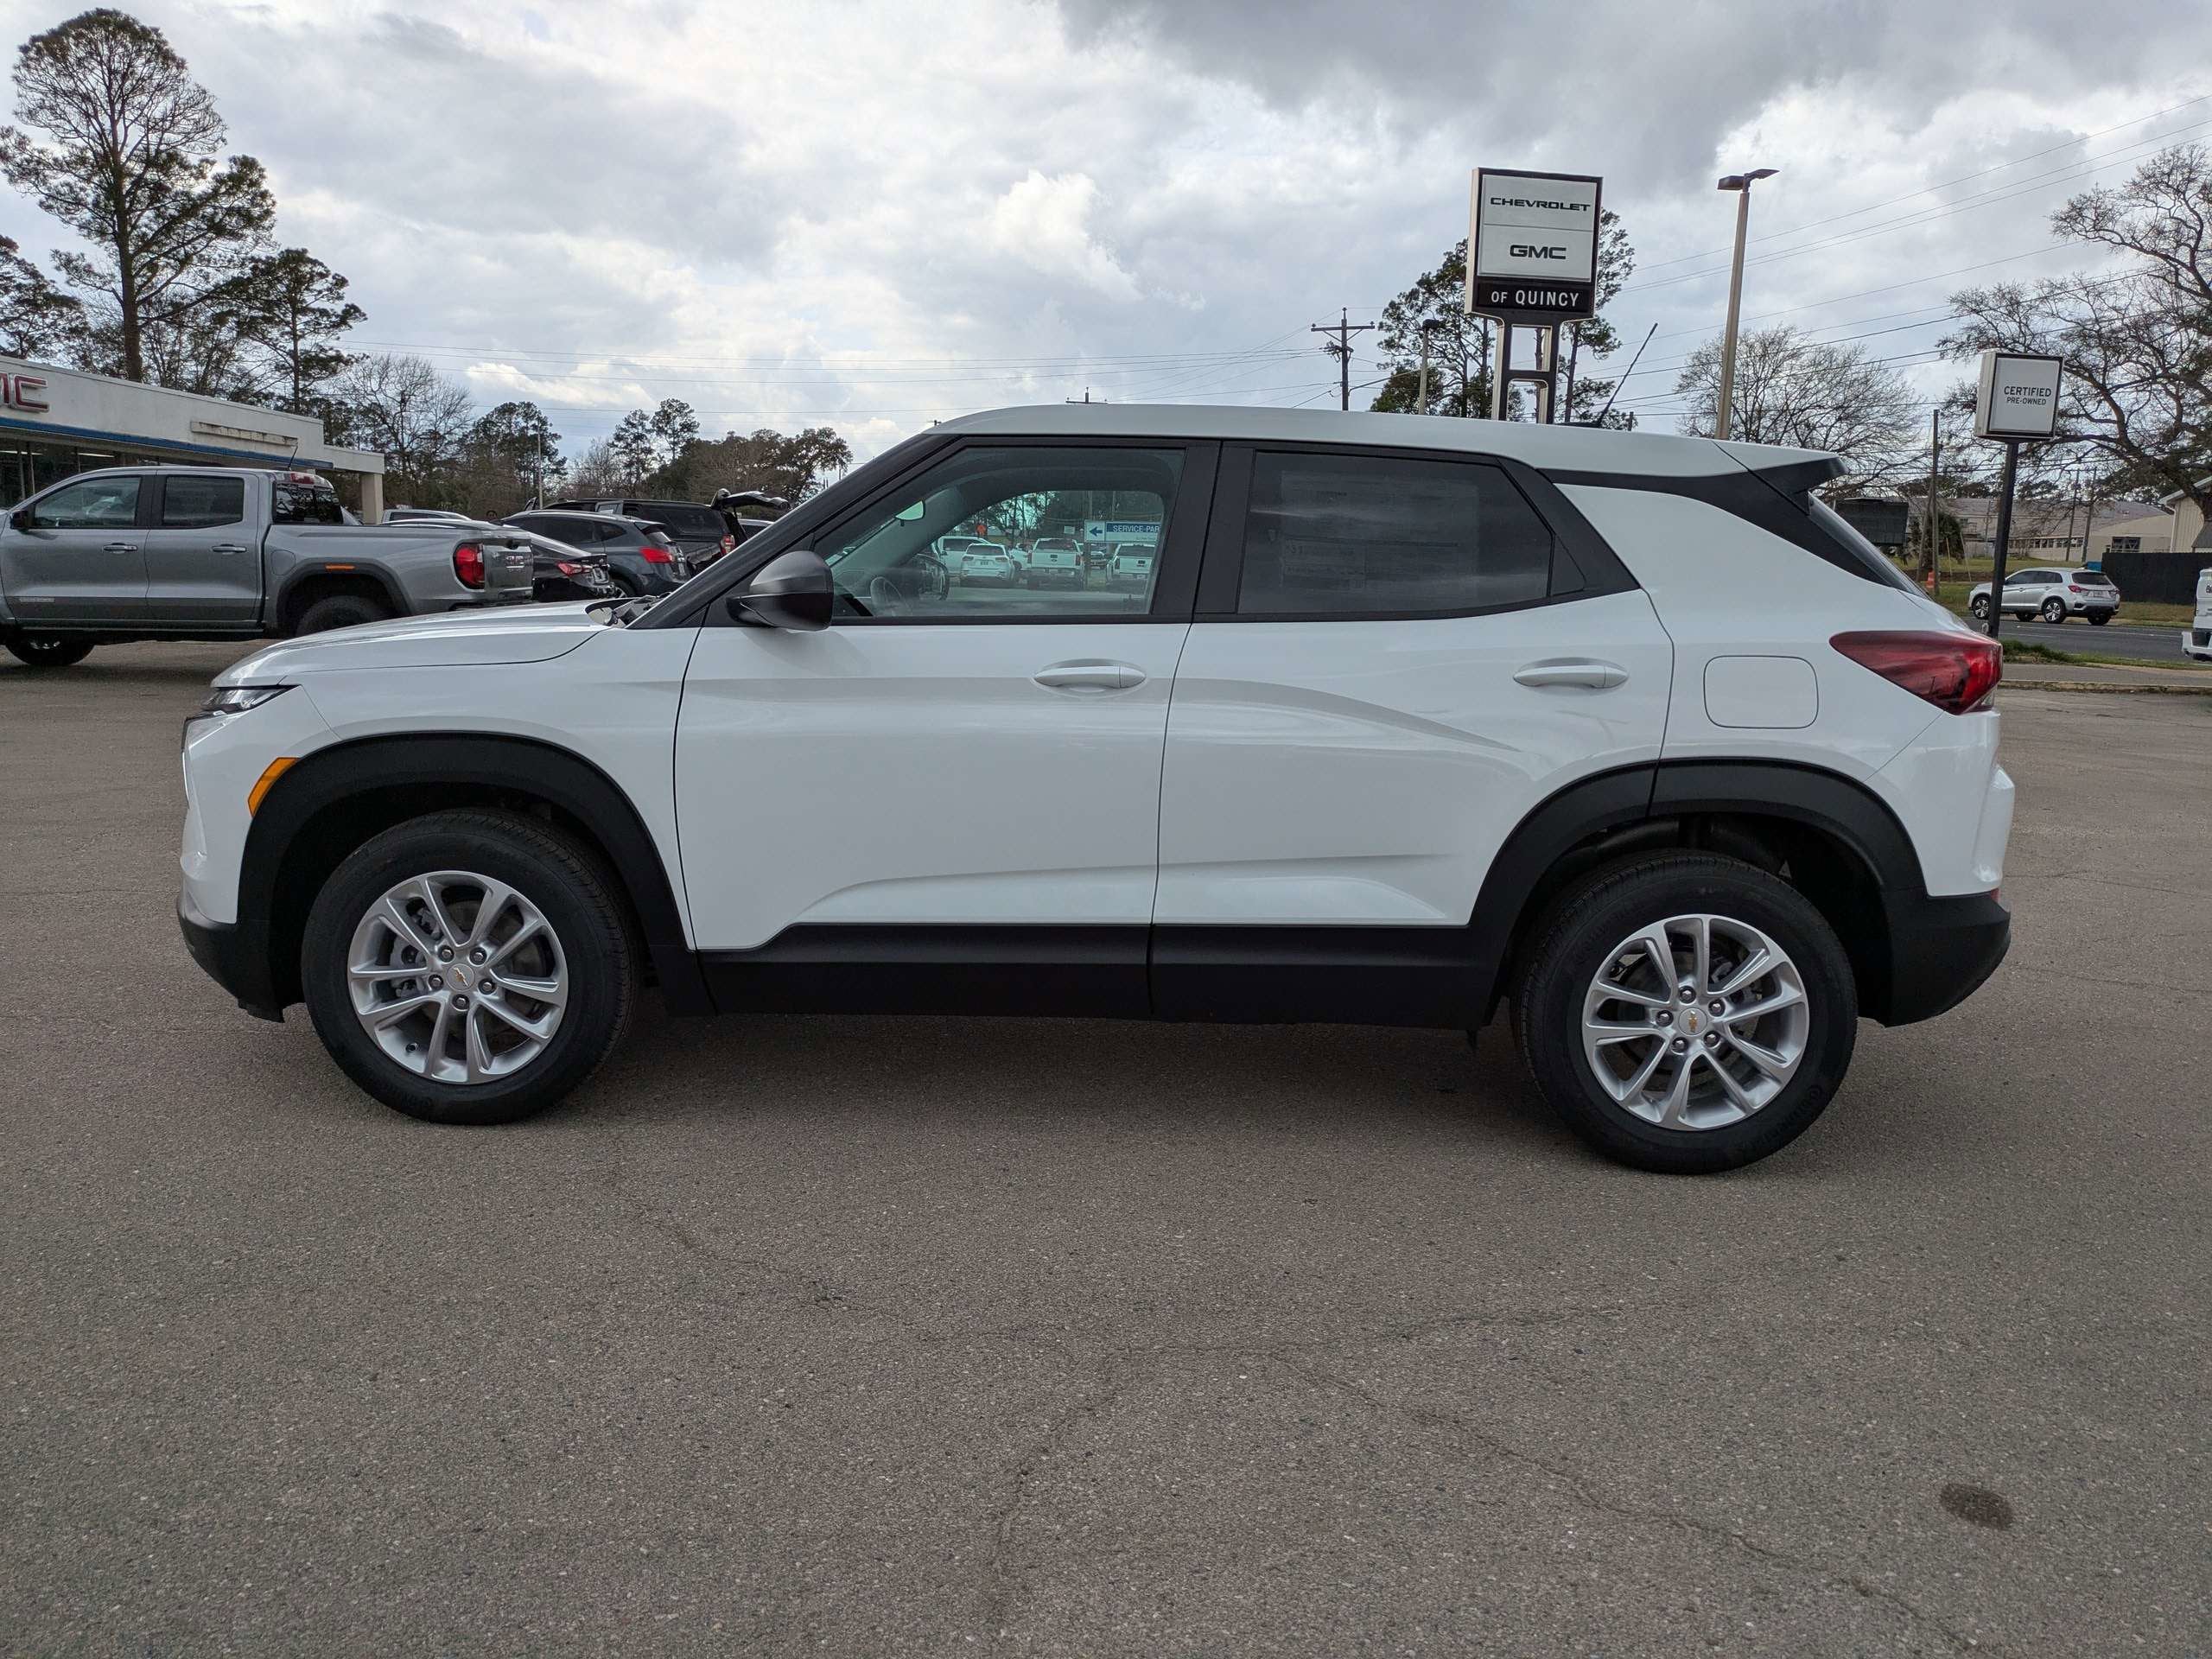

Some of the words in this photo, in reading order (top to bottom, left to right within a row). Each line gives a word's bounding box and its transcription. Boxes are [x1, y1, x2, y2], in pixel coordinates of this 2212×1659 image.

[1490, 197, 1591, 212] CHEVROLET
[1510, 245, 1567, 259] GMC
[1491, 291, 1508, 303] OF
[1515, 289, 1580, 307] QUINCY
[2004, 385, 2052, 397] CERTIFIED
[2006, 397, 2047, 405] PRE-OWNED
